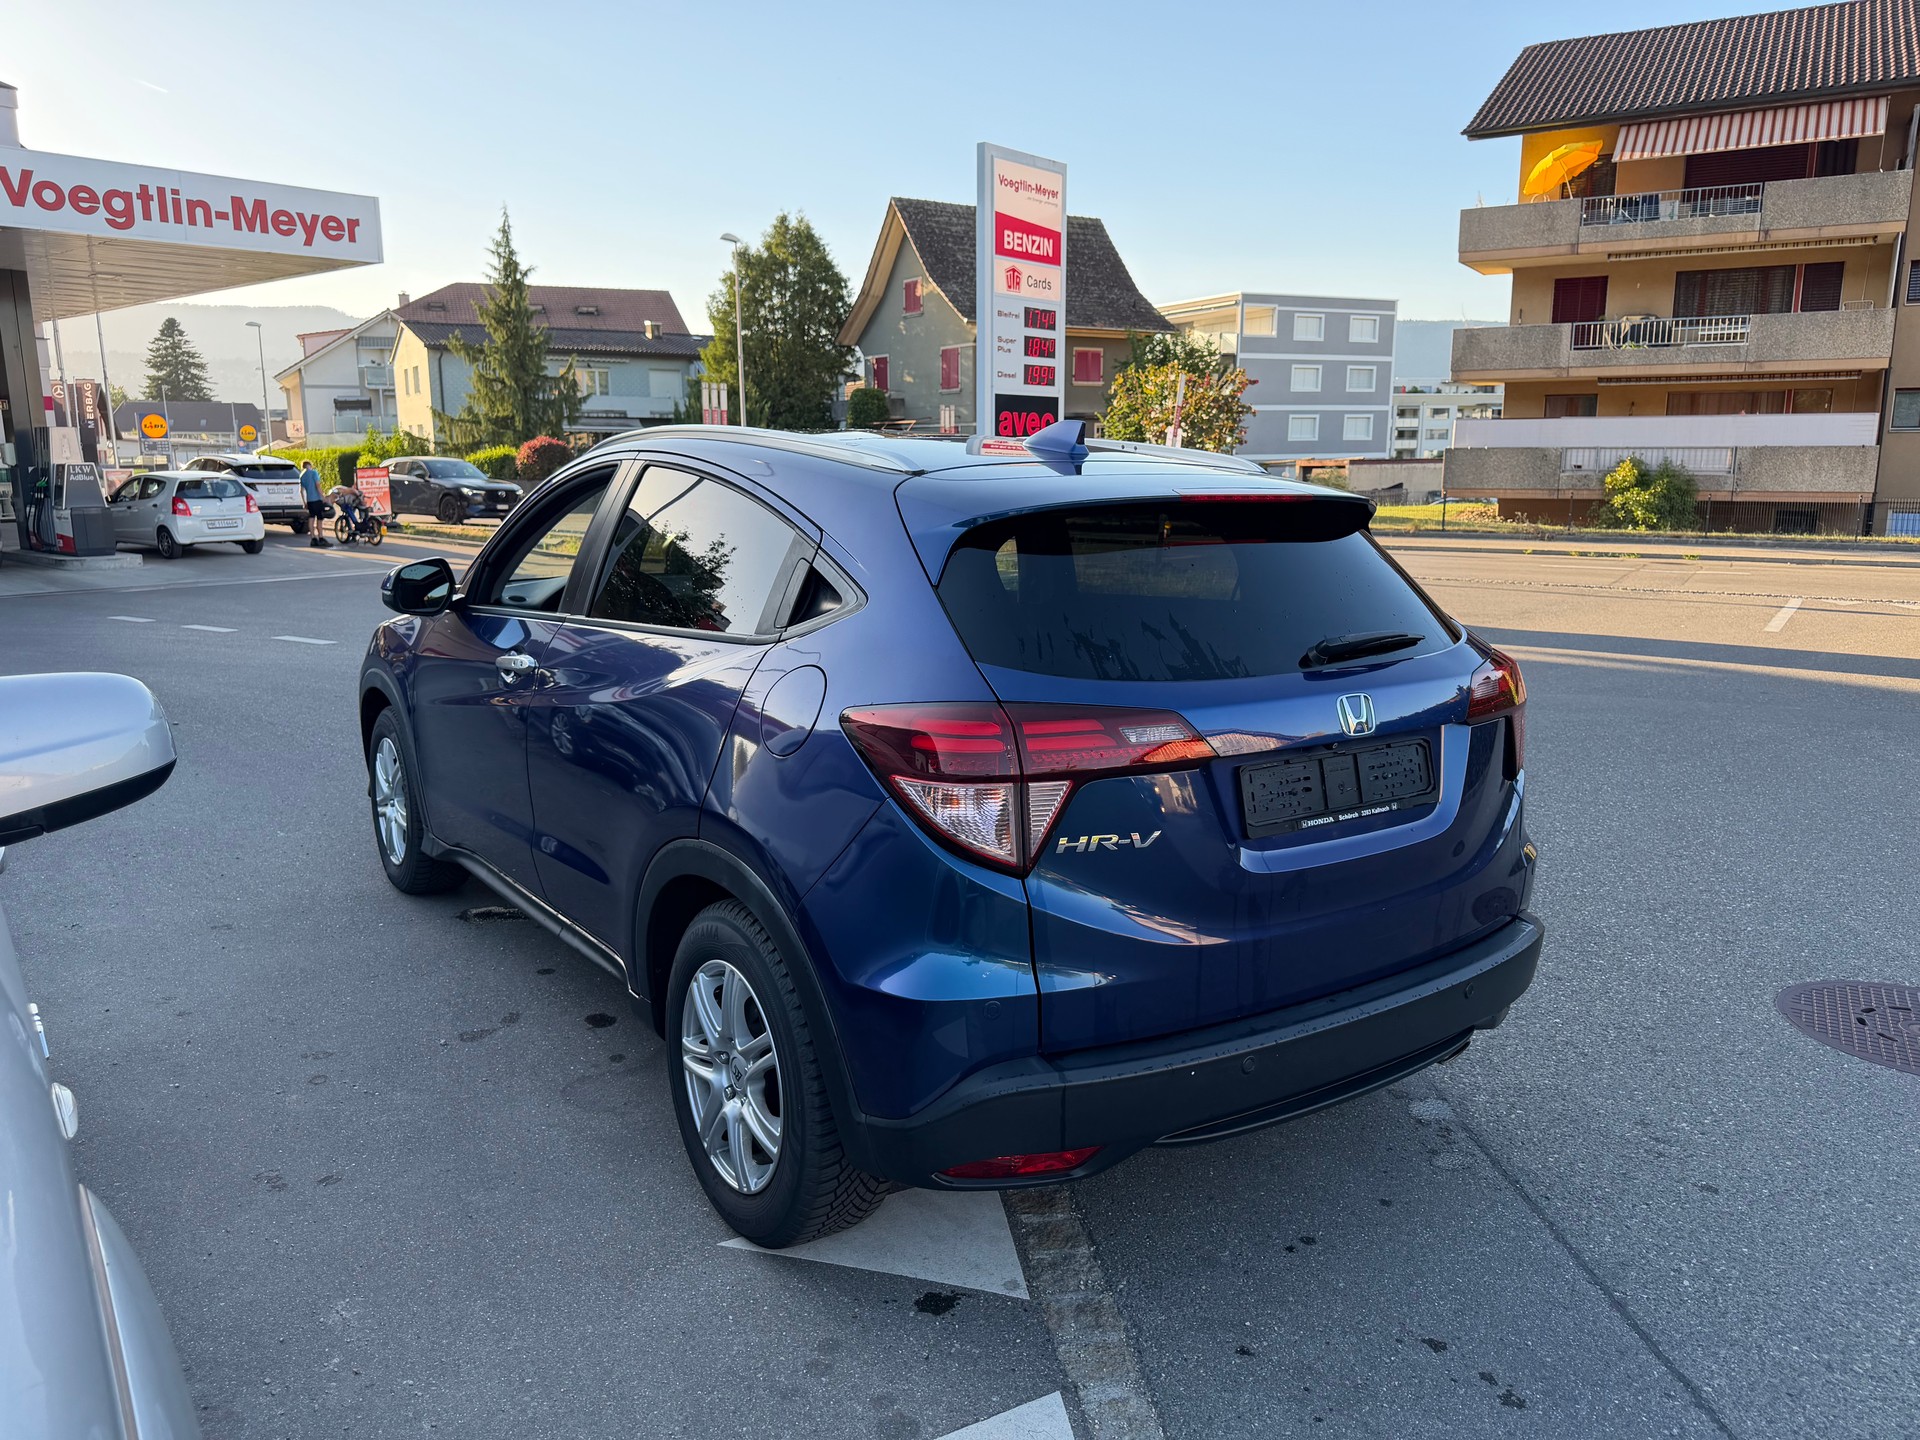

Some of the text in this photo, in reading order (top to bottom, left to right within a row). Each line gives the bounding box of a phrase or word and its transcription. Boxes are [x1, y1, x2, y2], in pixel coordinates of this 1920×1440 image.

[998, 174, 1059, 199] Voegtlin-Meyer
[0, 165, 361, 247] Voegtlin-Meyer
[1003, 229, 1054, 257] BENZIN
[1026, 275, 1052, 291] Cards
[997, 336, 1017, 345] Super
[997, 370, 1017, 379] Diesel
[83, 382, 95, 429] MERBAG
[69, 465, 92, 474] LKW
[1307, 816, 1335, 827] HONDA
[1055, 829, 1162, 854] HR-V
